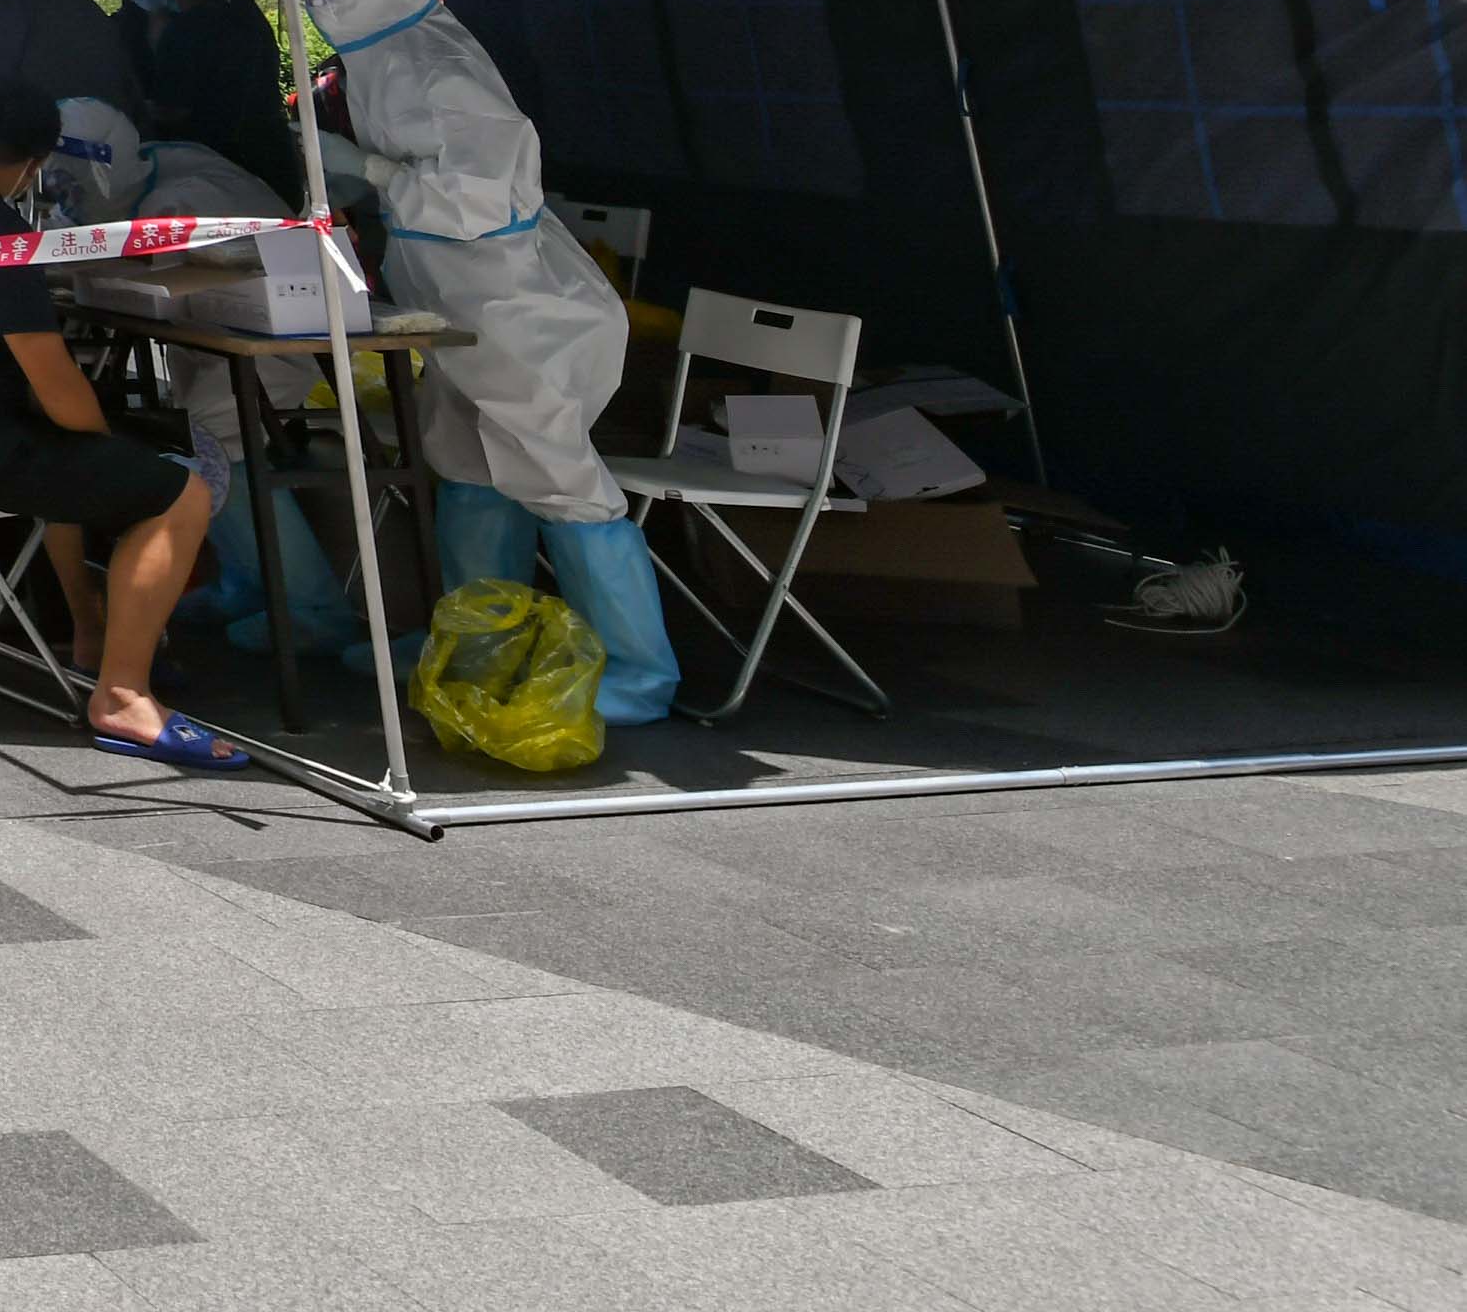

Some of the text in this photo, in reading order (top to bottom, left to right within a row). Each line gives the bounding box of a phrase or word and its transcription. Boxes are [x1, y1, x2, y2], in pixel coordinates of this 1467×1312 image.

[61, 228, 107, 247] 注意
[141, 220, 187, 238] 安全
[206, 222, 261, 240] CAUTION
[51, 244, 107, 258] CAUTION
[133, 235, 181, 249] SAFE
